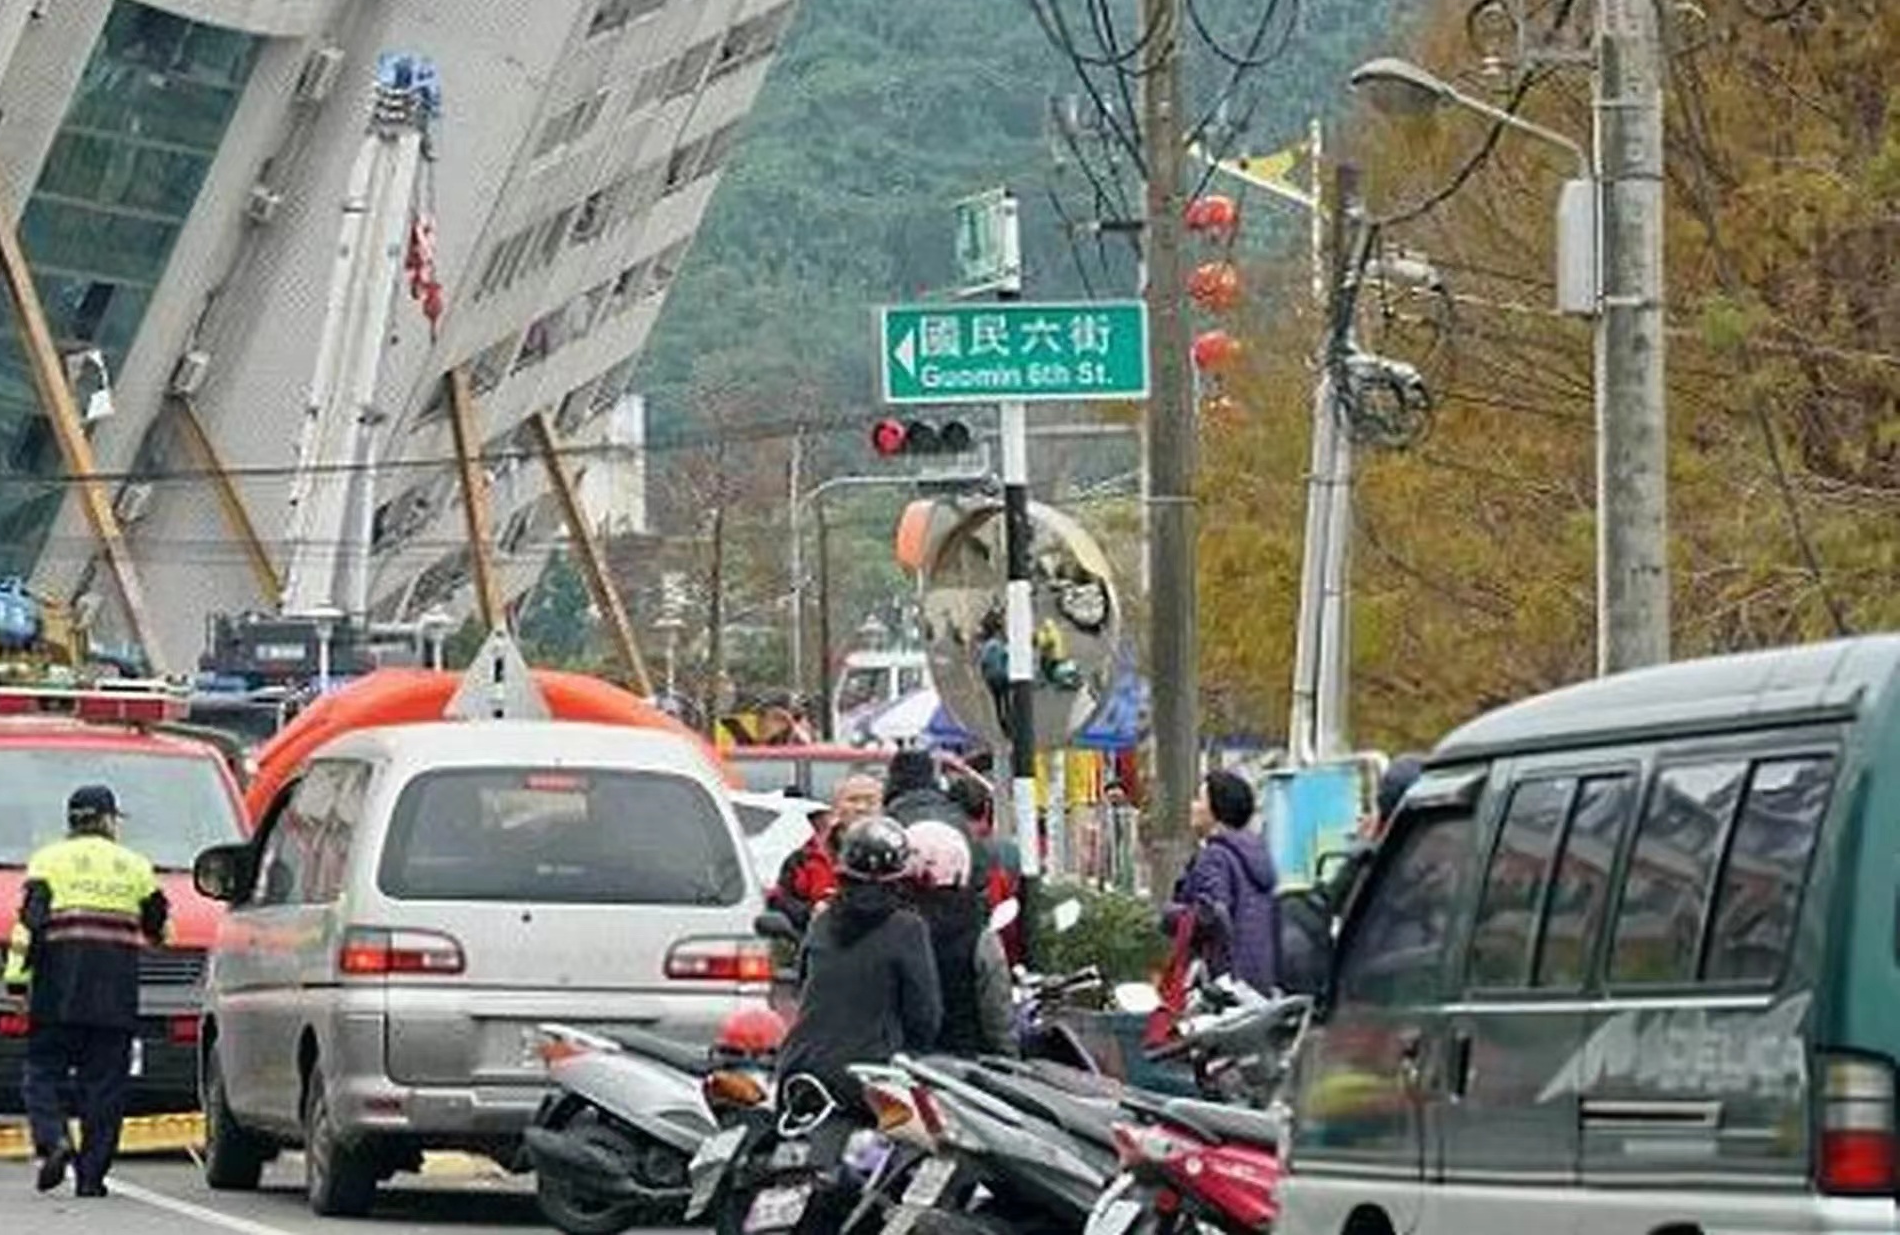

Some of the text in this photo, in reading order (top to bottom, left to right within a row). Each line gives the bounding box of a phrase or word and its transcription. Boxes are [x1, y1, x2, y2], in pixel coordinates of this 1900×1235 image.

[919, 313, 1113, 356] 國民六街
[920, 360, 1113, 389] Guomin 6th St.
